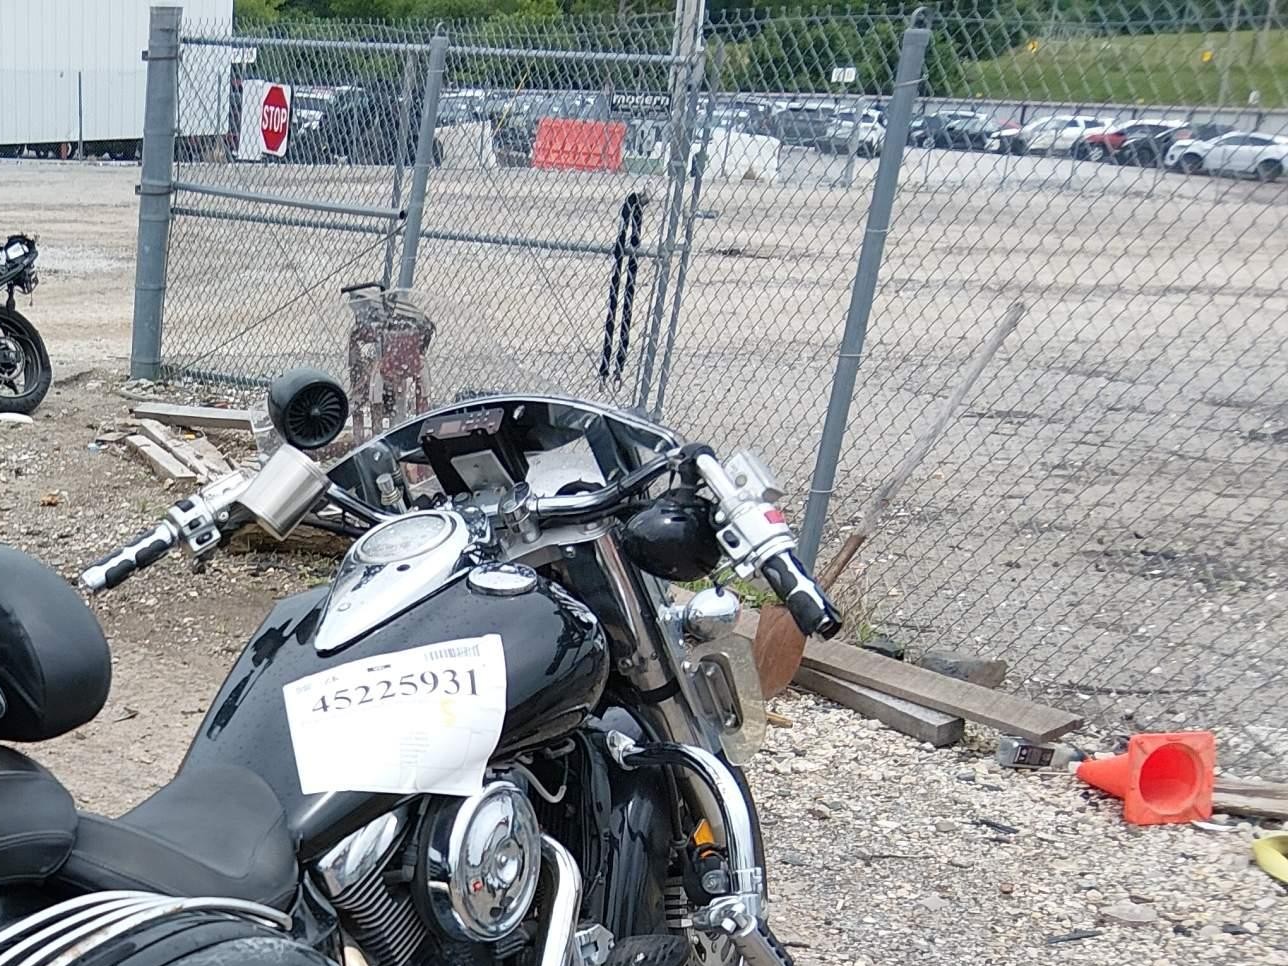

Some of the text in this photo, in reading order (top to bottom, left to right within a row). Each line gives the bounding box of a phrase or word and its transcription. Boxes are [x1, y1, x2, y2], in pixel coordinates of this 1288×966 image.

[613, 93, 670, 105] modern
[262, 105, 288, 133] STOP
[312, 668, 481, 713] 45225931
